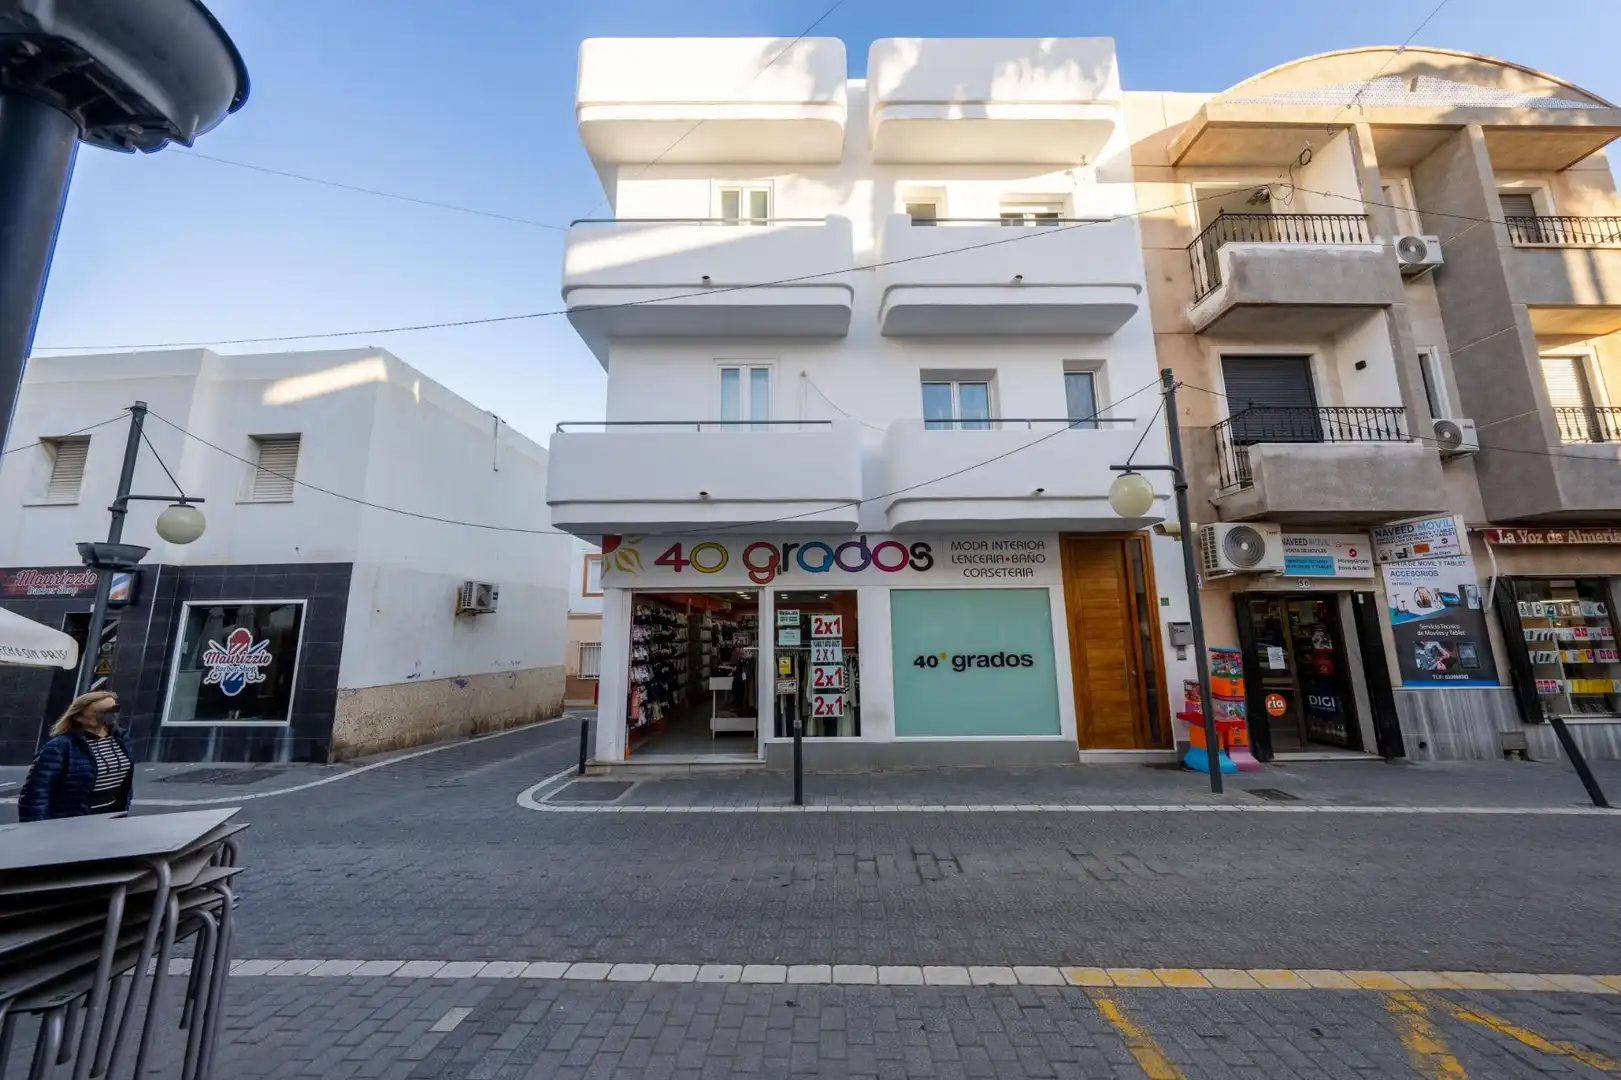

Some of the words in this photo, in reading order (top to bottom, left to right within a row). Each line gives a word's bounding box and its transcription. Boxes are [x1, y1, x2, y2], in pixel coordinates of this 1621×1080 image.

[1375, 525, 1415, 538] NAVEED
[1417, 518, 1454, 530] MOVIL
[1496, 529, 1516, 544] La
[1517, 529, 1544, 544] Voz
[1546, 529, 1564, 544] de
[951, 541, 988, 551] MODA
[992, 540, 1046, 550] INTERIOR
[654, 542, 729, 573] 40
[742, 535, 934, 585] grados
[16, 569, 98, 587] Maurizzio
[963, 567, 1034, 578] CORSETERIA
[57, 586, 79, 597] Shop
[814, 616, 842, 635] 2x1
[204, 651, 271, 665] Maurizzio
[951, 651, 1034, 672] grados
[215, 665, 241, 673] Barber
[241, 665, 257, 673] Shop
[814, 666, 843, 687] 2x1
[814, 695, 843, 715] 2x1
[1267, 696, 1284, 709] ria
[1308, 695, 1336, 708] DIGI
